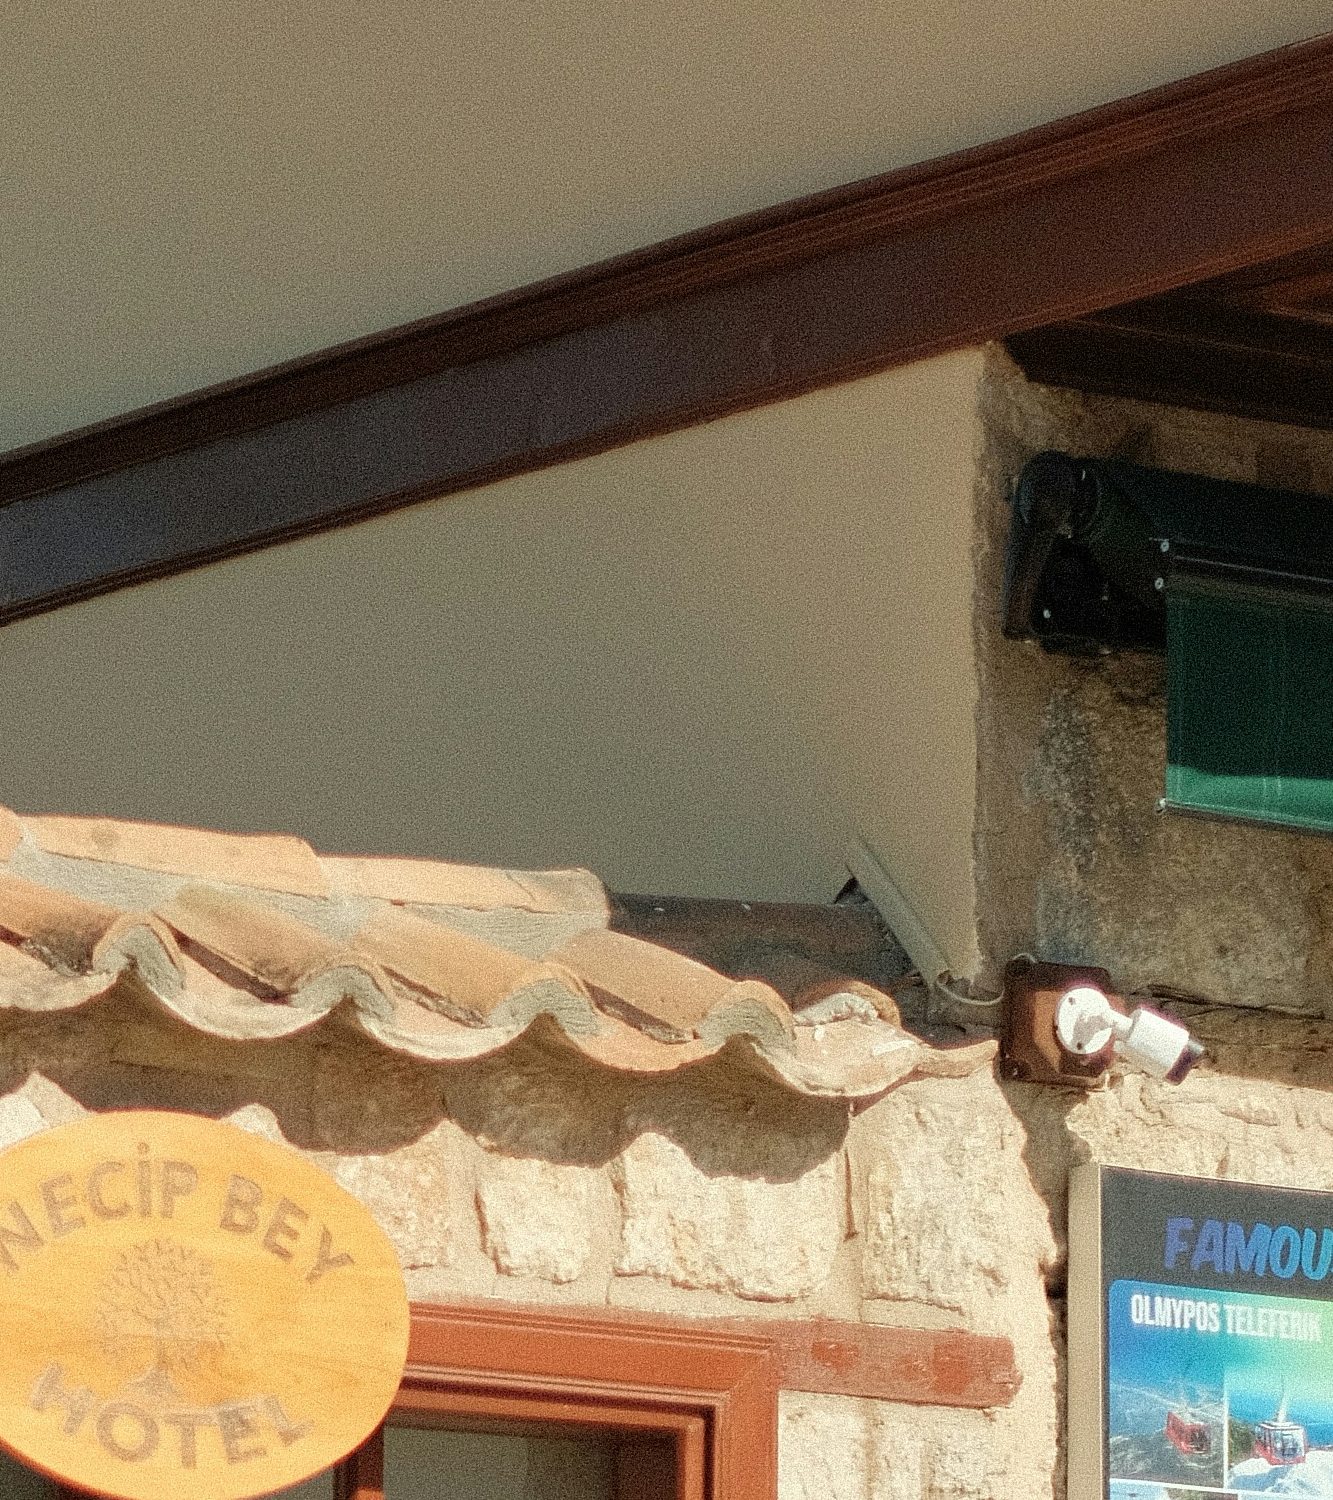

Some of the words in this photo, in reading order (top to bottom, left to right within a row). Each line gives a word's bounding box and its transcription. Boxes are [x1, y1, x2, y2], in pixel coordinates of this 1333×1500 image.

[219, 1173, 355, 1285] BEY
[1164, 1216, 1333, 1281] FAMOU
[1131, 1294, 1220, 1333] OLMYPOS
[31, 1362, 315, 1469] HOTEL
